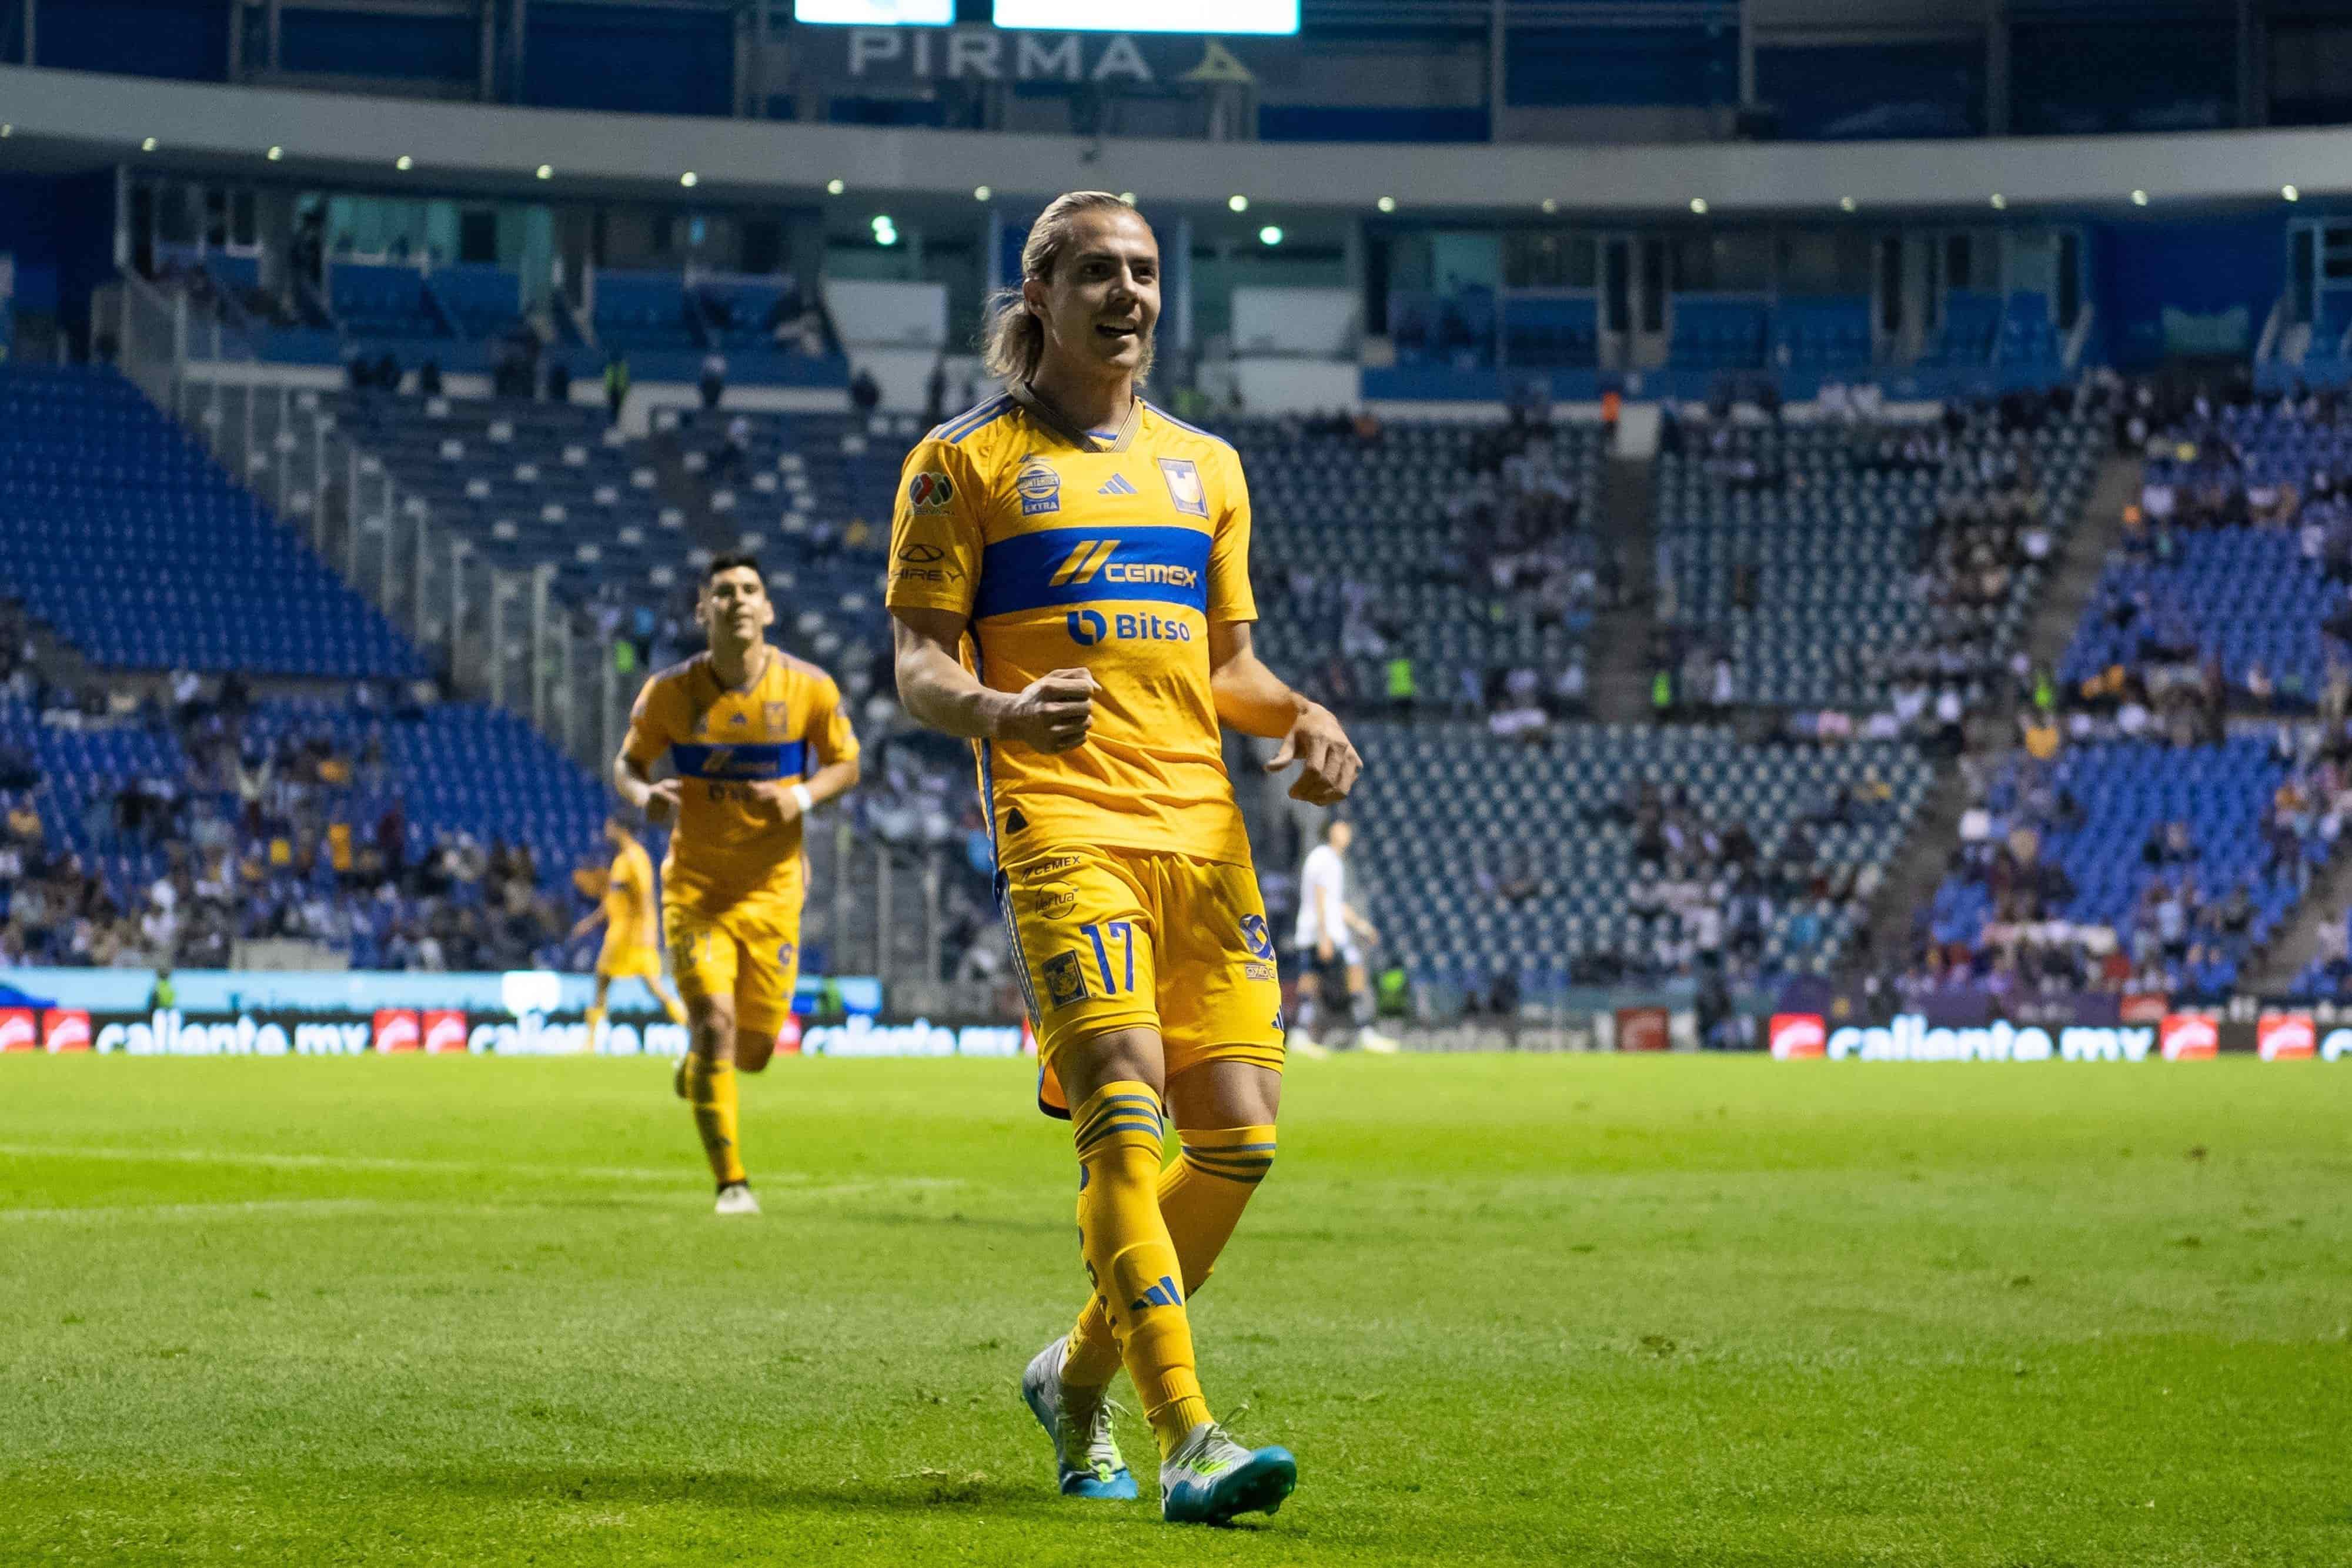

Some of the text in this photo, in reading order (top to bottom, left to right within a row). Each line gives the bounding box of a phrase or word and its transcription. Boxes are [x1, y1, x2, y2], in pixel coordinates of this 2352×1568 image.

[847, 28, 1154, 81] PIRMA
[1105, 563, 1197, 589] CEMEX
[1115, 611, 1191, 642] Bitso
[1035, 855, 1081, 875] CEMEX
[1079, 921, 1134, 995] 17
